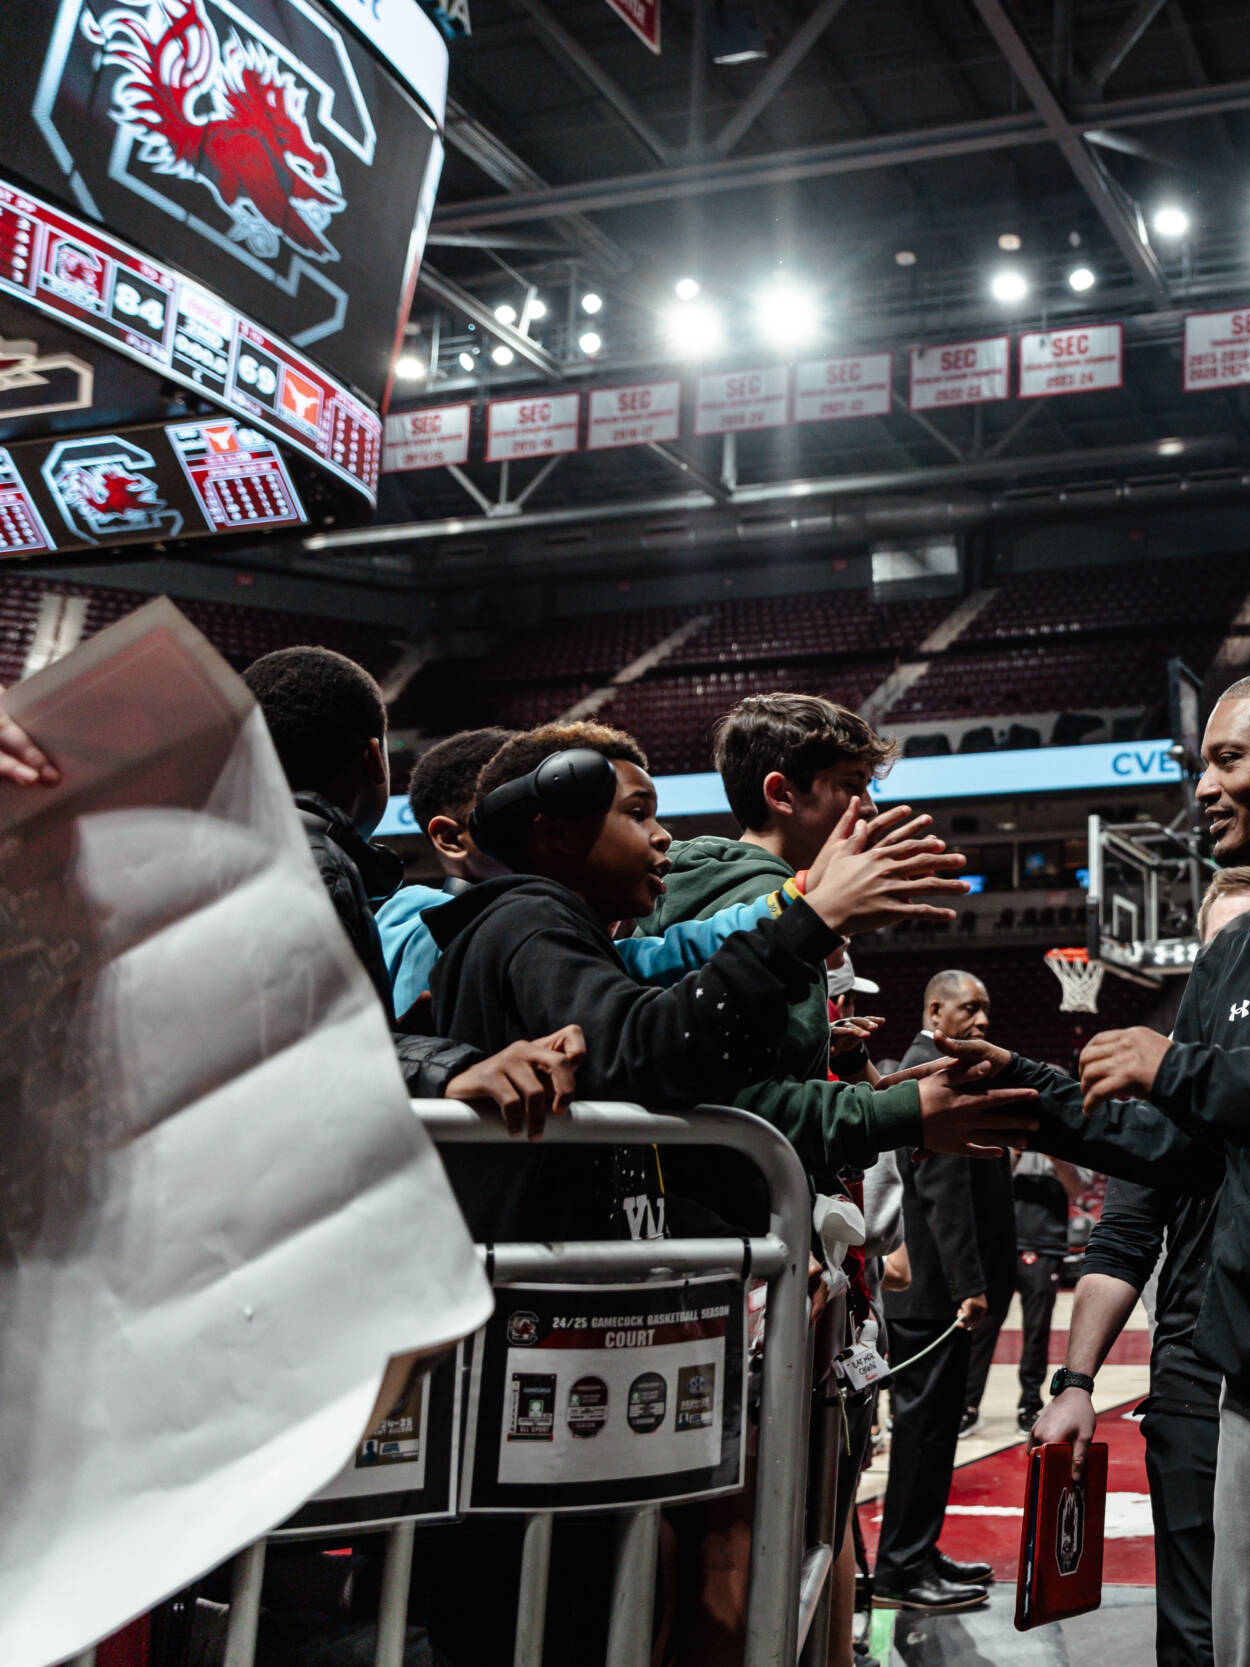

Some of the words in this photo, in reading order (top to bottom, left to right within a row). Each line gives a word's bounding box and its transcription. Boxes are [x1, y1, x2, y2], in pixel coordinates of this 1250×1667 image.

[114, 282, 165, 330] 84
[1052, 335, 1090, 358] SEC
[941, 348, 977, 370] SEC
[238, 354, 277, 395] 69
[827, 362, 861, 384] SEC
[725, 376, 761, 398] SEC
[618, 392, 651, 412] SEC
[519, 403, 552, 424] SEC
[410, 415, 442, 436] SEC
[552, 1316, 588, 1329] 24/25
[591, 1315, 644, 1329] GAMECOCK
[647, 1309, 699, 1326] BASKETBALL
[701, 1304, 730, 1319] SEASON
[605, 1329, 656, 1348] COURT
